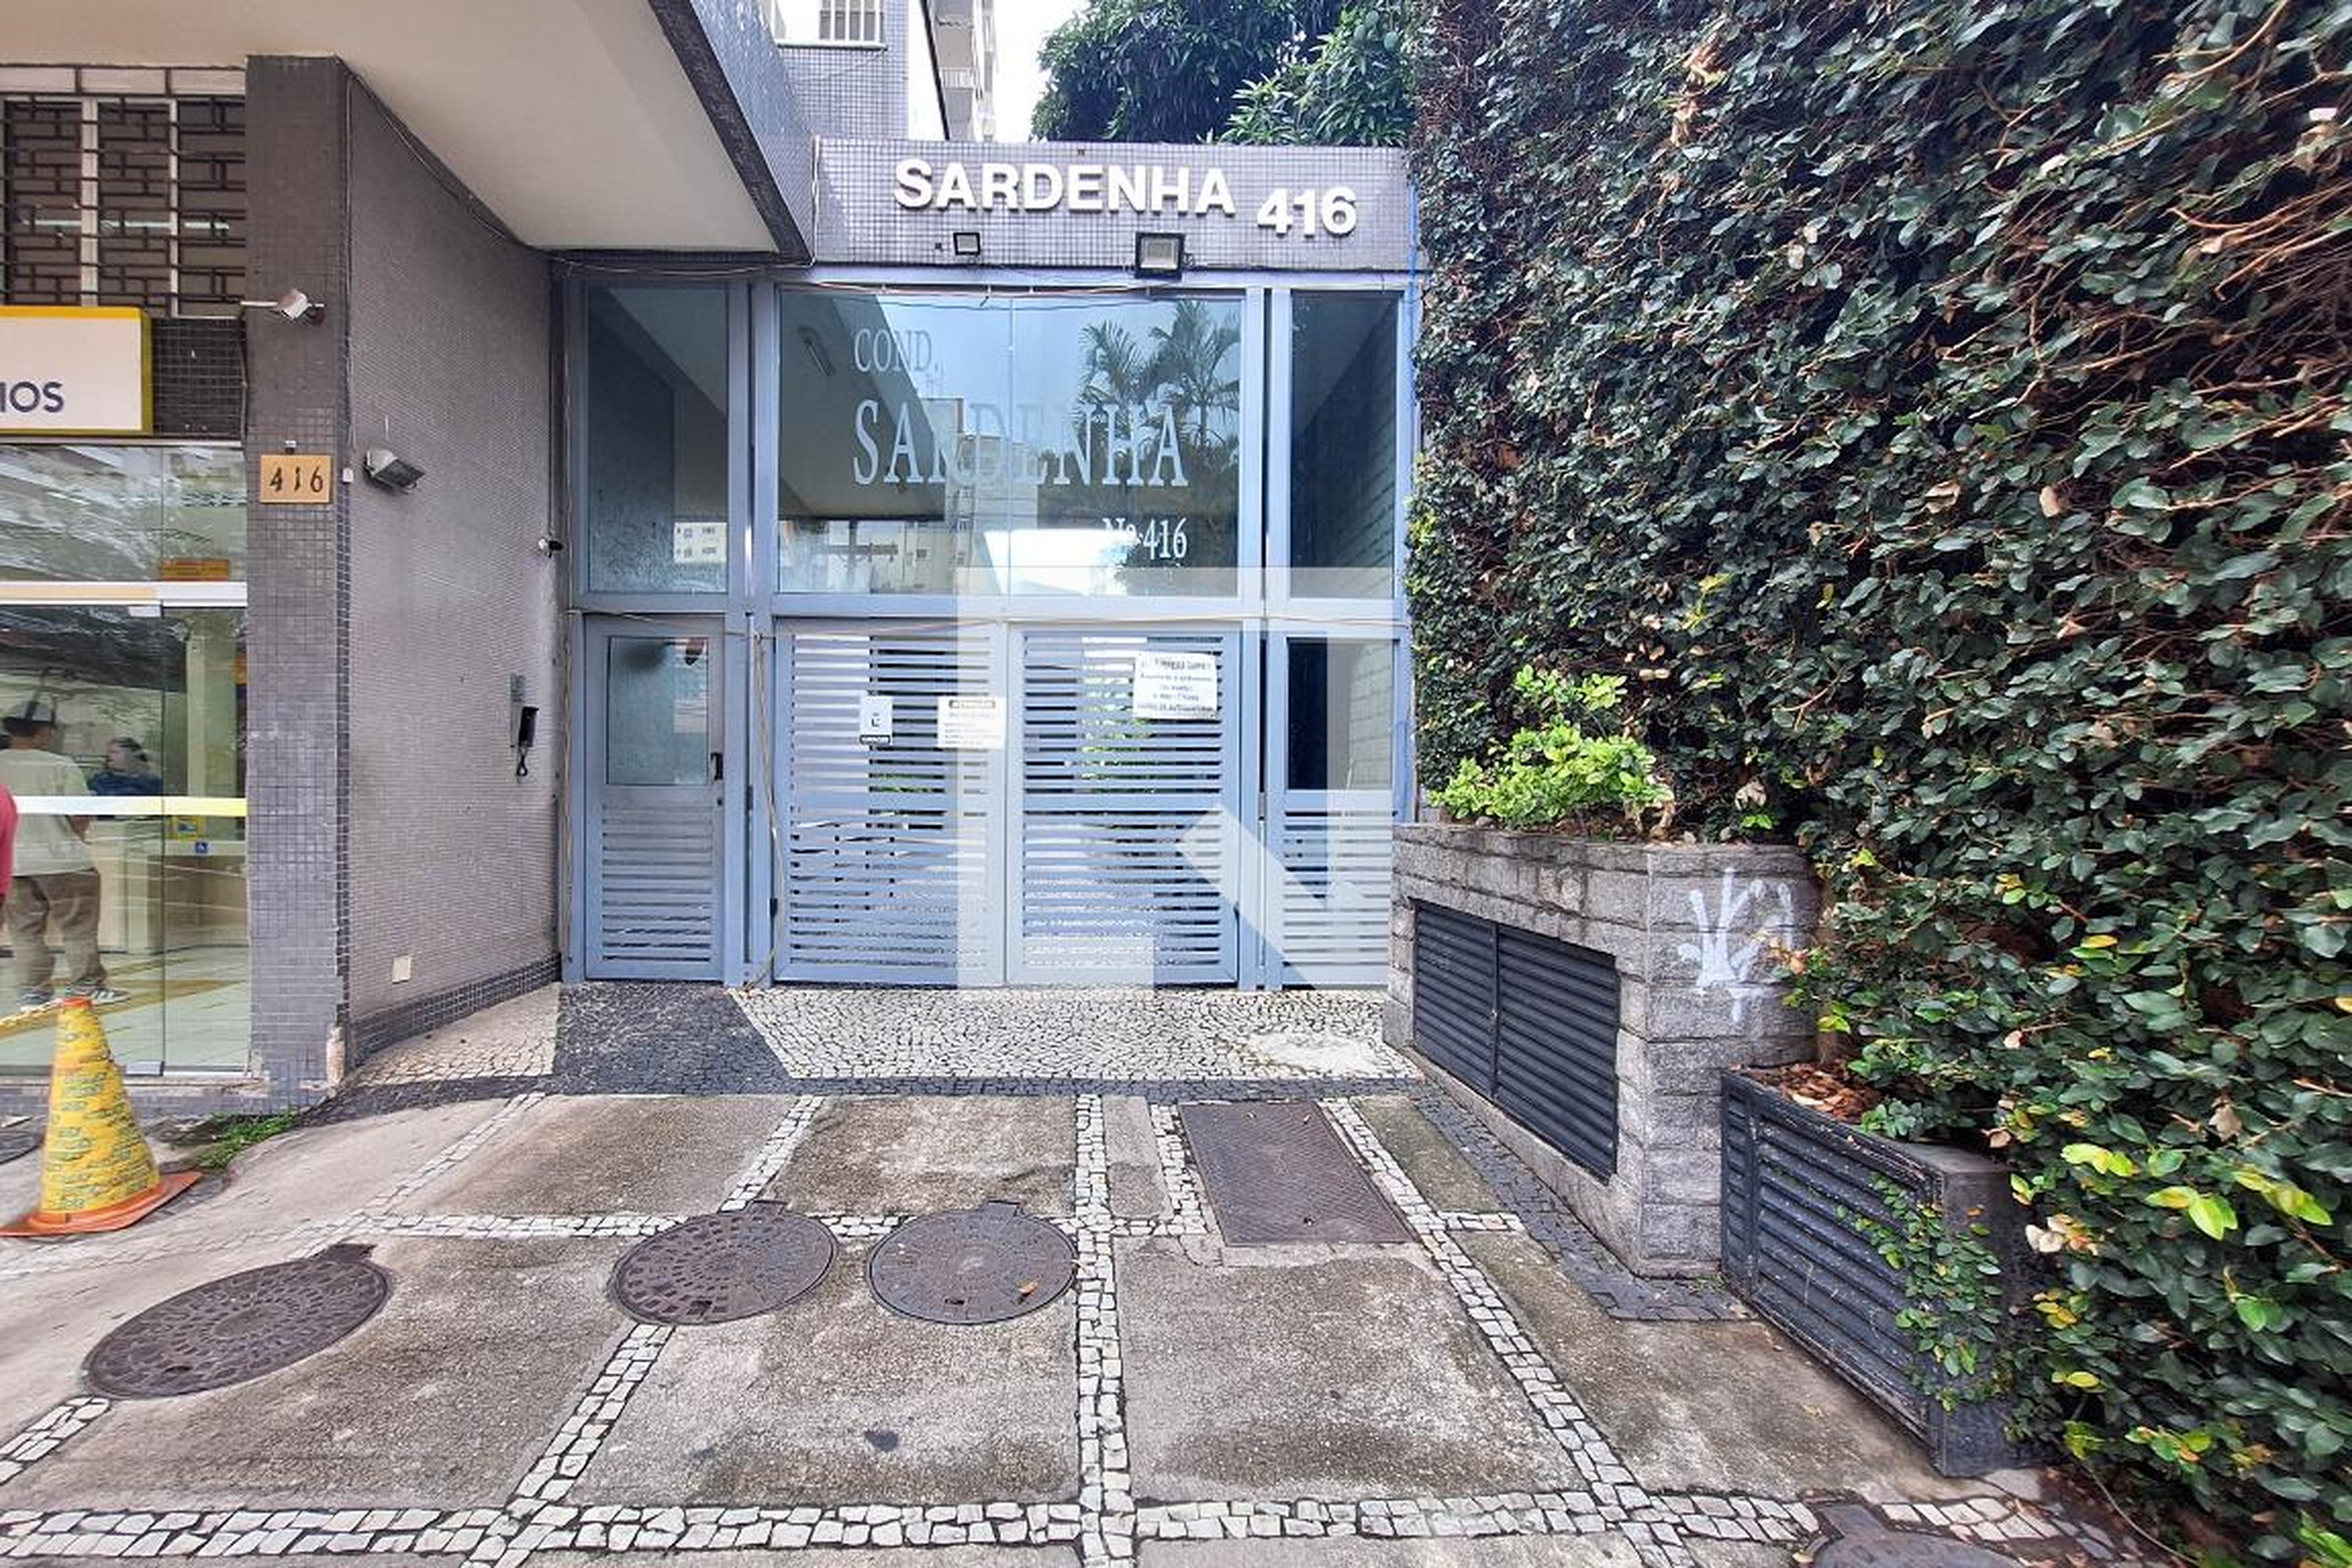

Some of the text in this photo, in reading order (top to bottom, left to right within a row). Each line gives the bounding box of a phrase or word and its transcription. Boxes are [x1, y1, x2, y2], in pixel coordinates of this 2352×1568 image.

[894, 159, 1358, 240] SARDENHA 416
[853, 399, 1189, 487] SARDENHA
[269, 466, 323, 493] 416
[1142, 517, 1188, 560] 416
